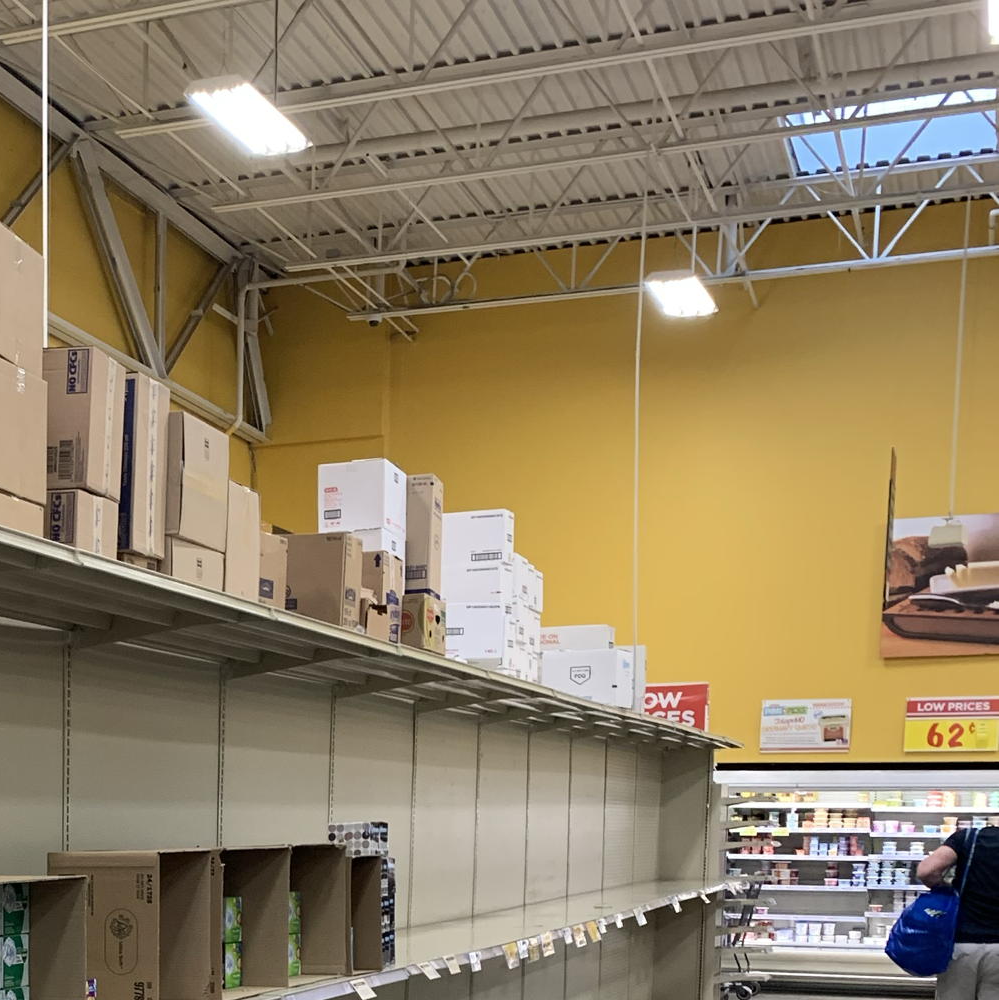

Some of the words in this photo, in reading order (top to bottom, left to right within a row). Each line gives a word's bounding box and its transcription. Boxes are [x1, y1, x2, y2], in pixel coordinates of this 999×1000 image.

[69, 350, 78, 376] CFCs
[68, 377, 76, 392] NO
[52, 494, 62, 525] CFCs
[644, 692, 683, 710] OW
[917, 702, 946, 712] LOW
[948, 702, 990, 711] PRICES
